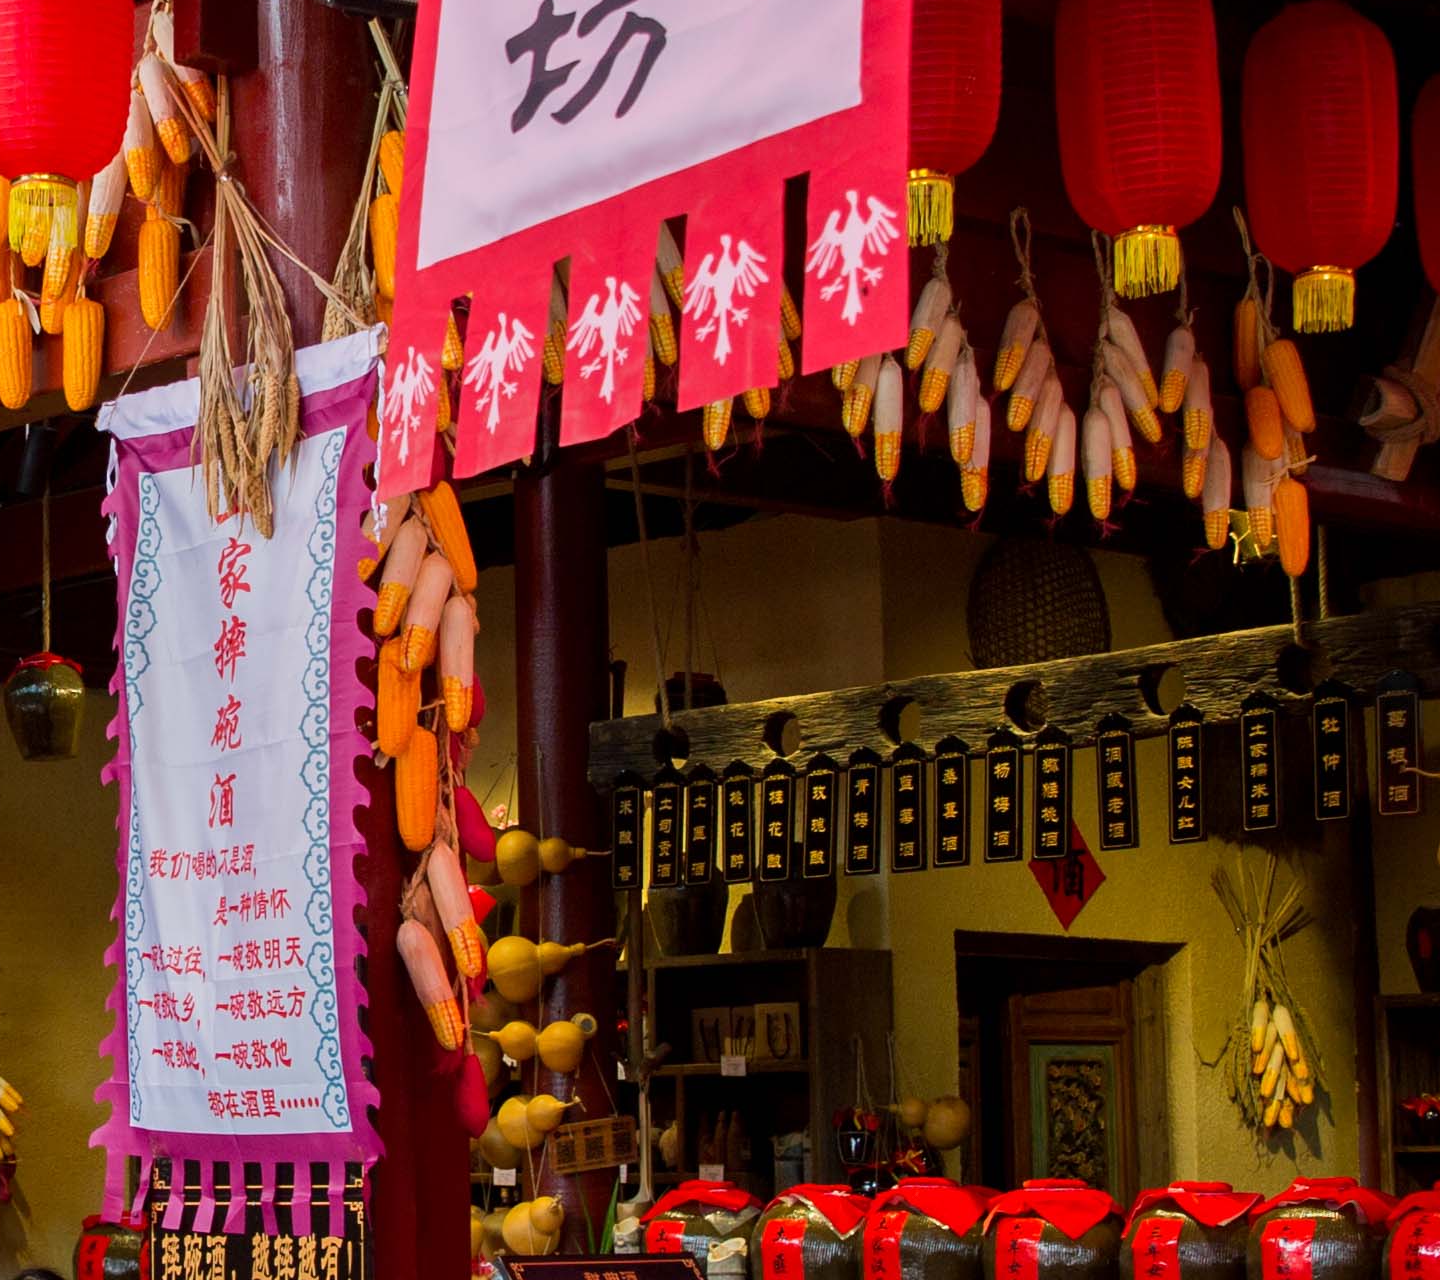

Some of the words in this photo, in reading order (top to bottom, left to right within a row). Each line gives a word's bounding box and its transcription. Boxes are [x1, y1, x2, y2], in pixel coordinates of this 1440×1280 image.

[208, 498, 253, 830] 家摔碗酒
[992, 761, 1012, 848] 杨梅酒
[1040, 756, 1060, 848] 猕猴桃酒
[1248, 723, 1271, 820] 土家糯米酒
[1320, 716, 1344, 809] 杜仲酒
[852, 777, 871, 861] 青梅酒
[212, 887, 293, 926] 是一种情怀
[217, 936, 305, 972] 一碗敬明天
[215, 986, 307, 1021] 一碗敬远方
[214, 1038, 293, 1071] 一碗敬他
